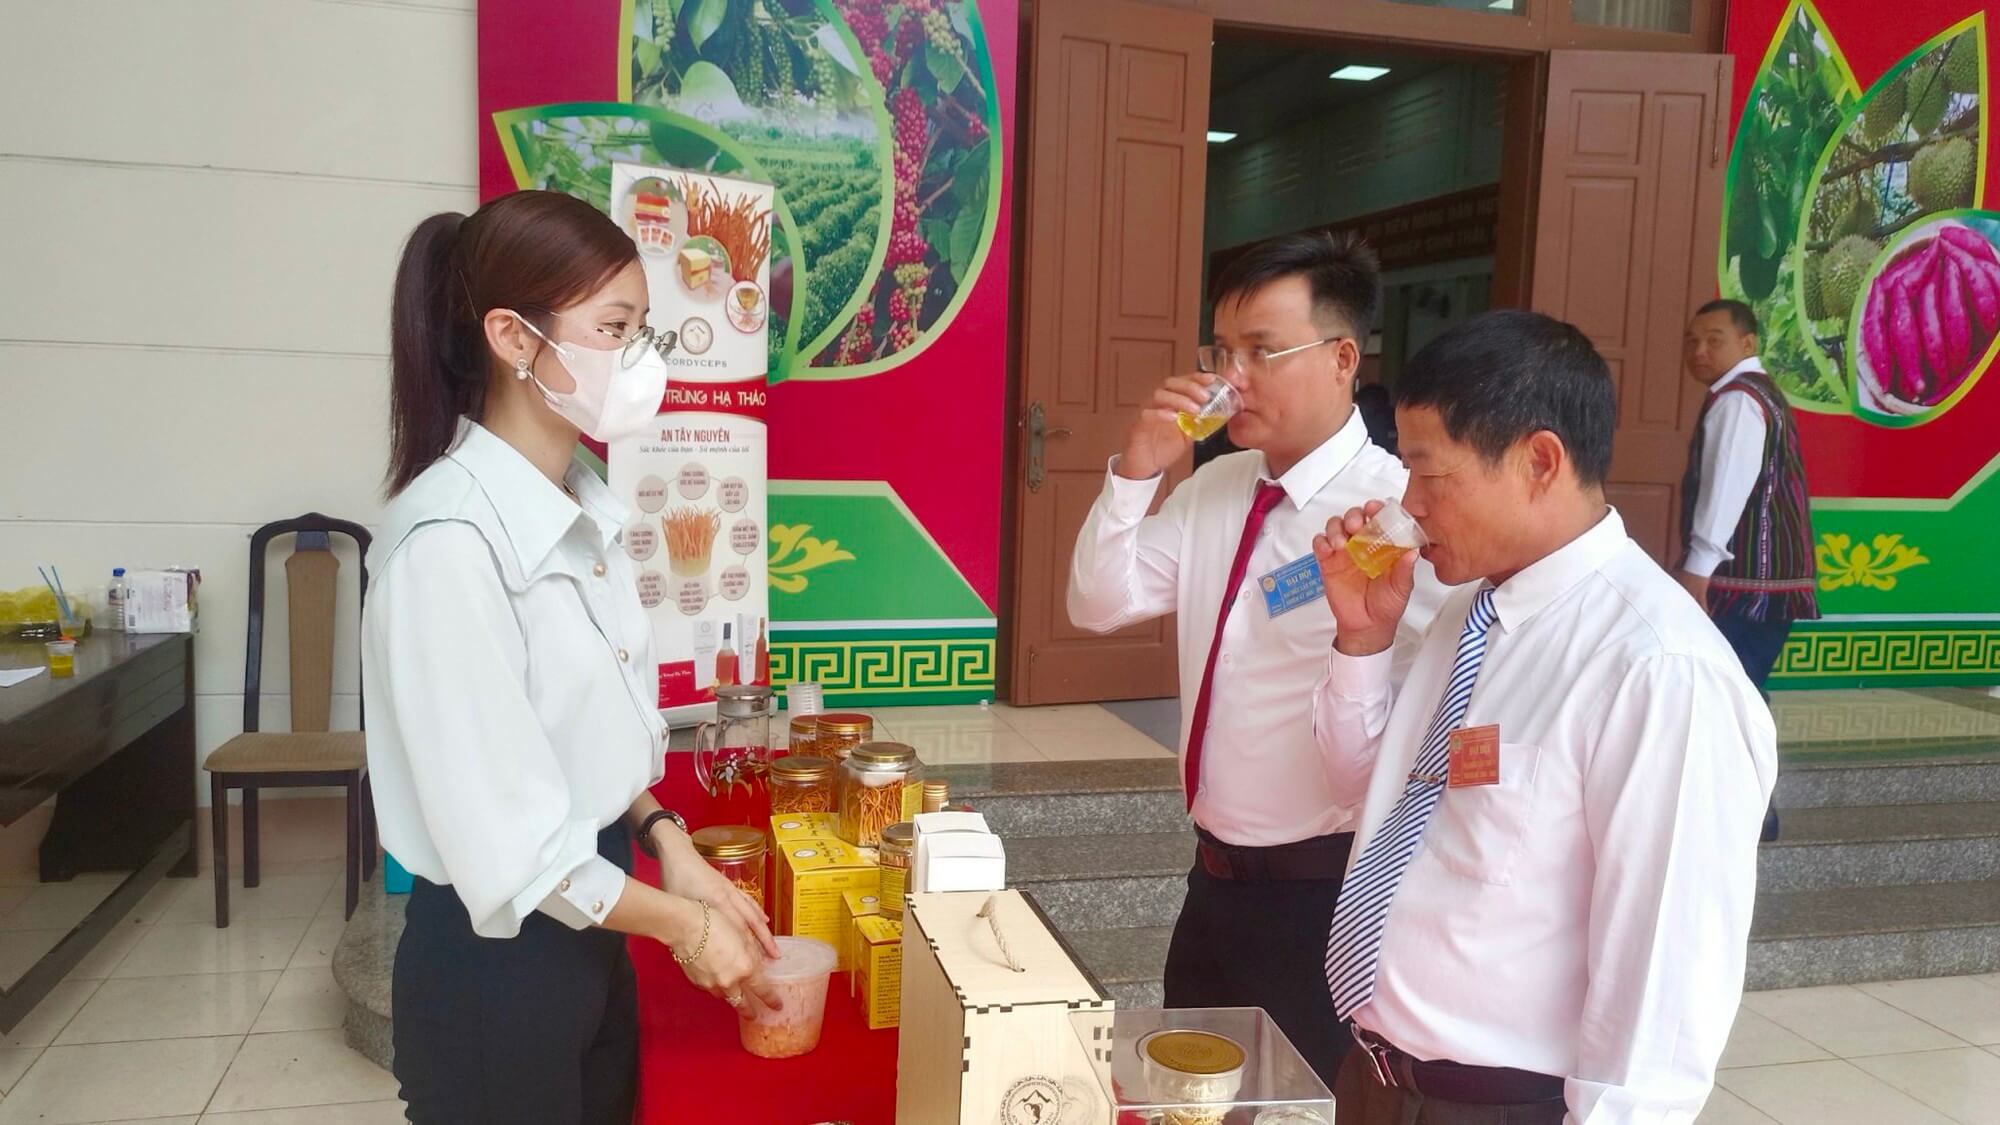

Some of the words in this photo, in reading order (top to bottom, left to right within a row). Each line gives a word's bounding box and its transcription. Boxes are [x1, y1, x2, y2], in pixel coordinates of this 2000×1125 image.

[664, 358, 728, 368] CORDYCEPS
[665, 386, 708, 404] TRÙNG
[713, 389, 732, 407] HẠ
[737, 388, 766, 406] THẢO
[661, 429, 673, 442] AN
[675, 427, 692, 442] TÂY
[694, 427, 730, 442] NGUYÊN
